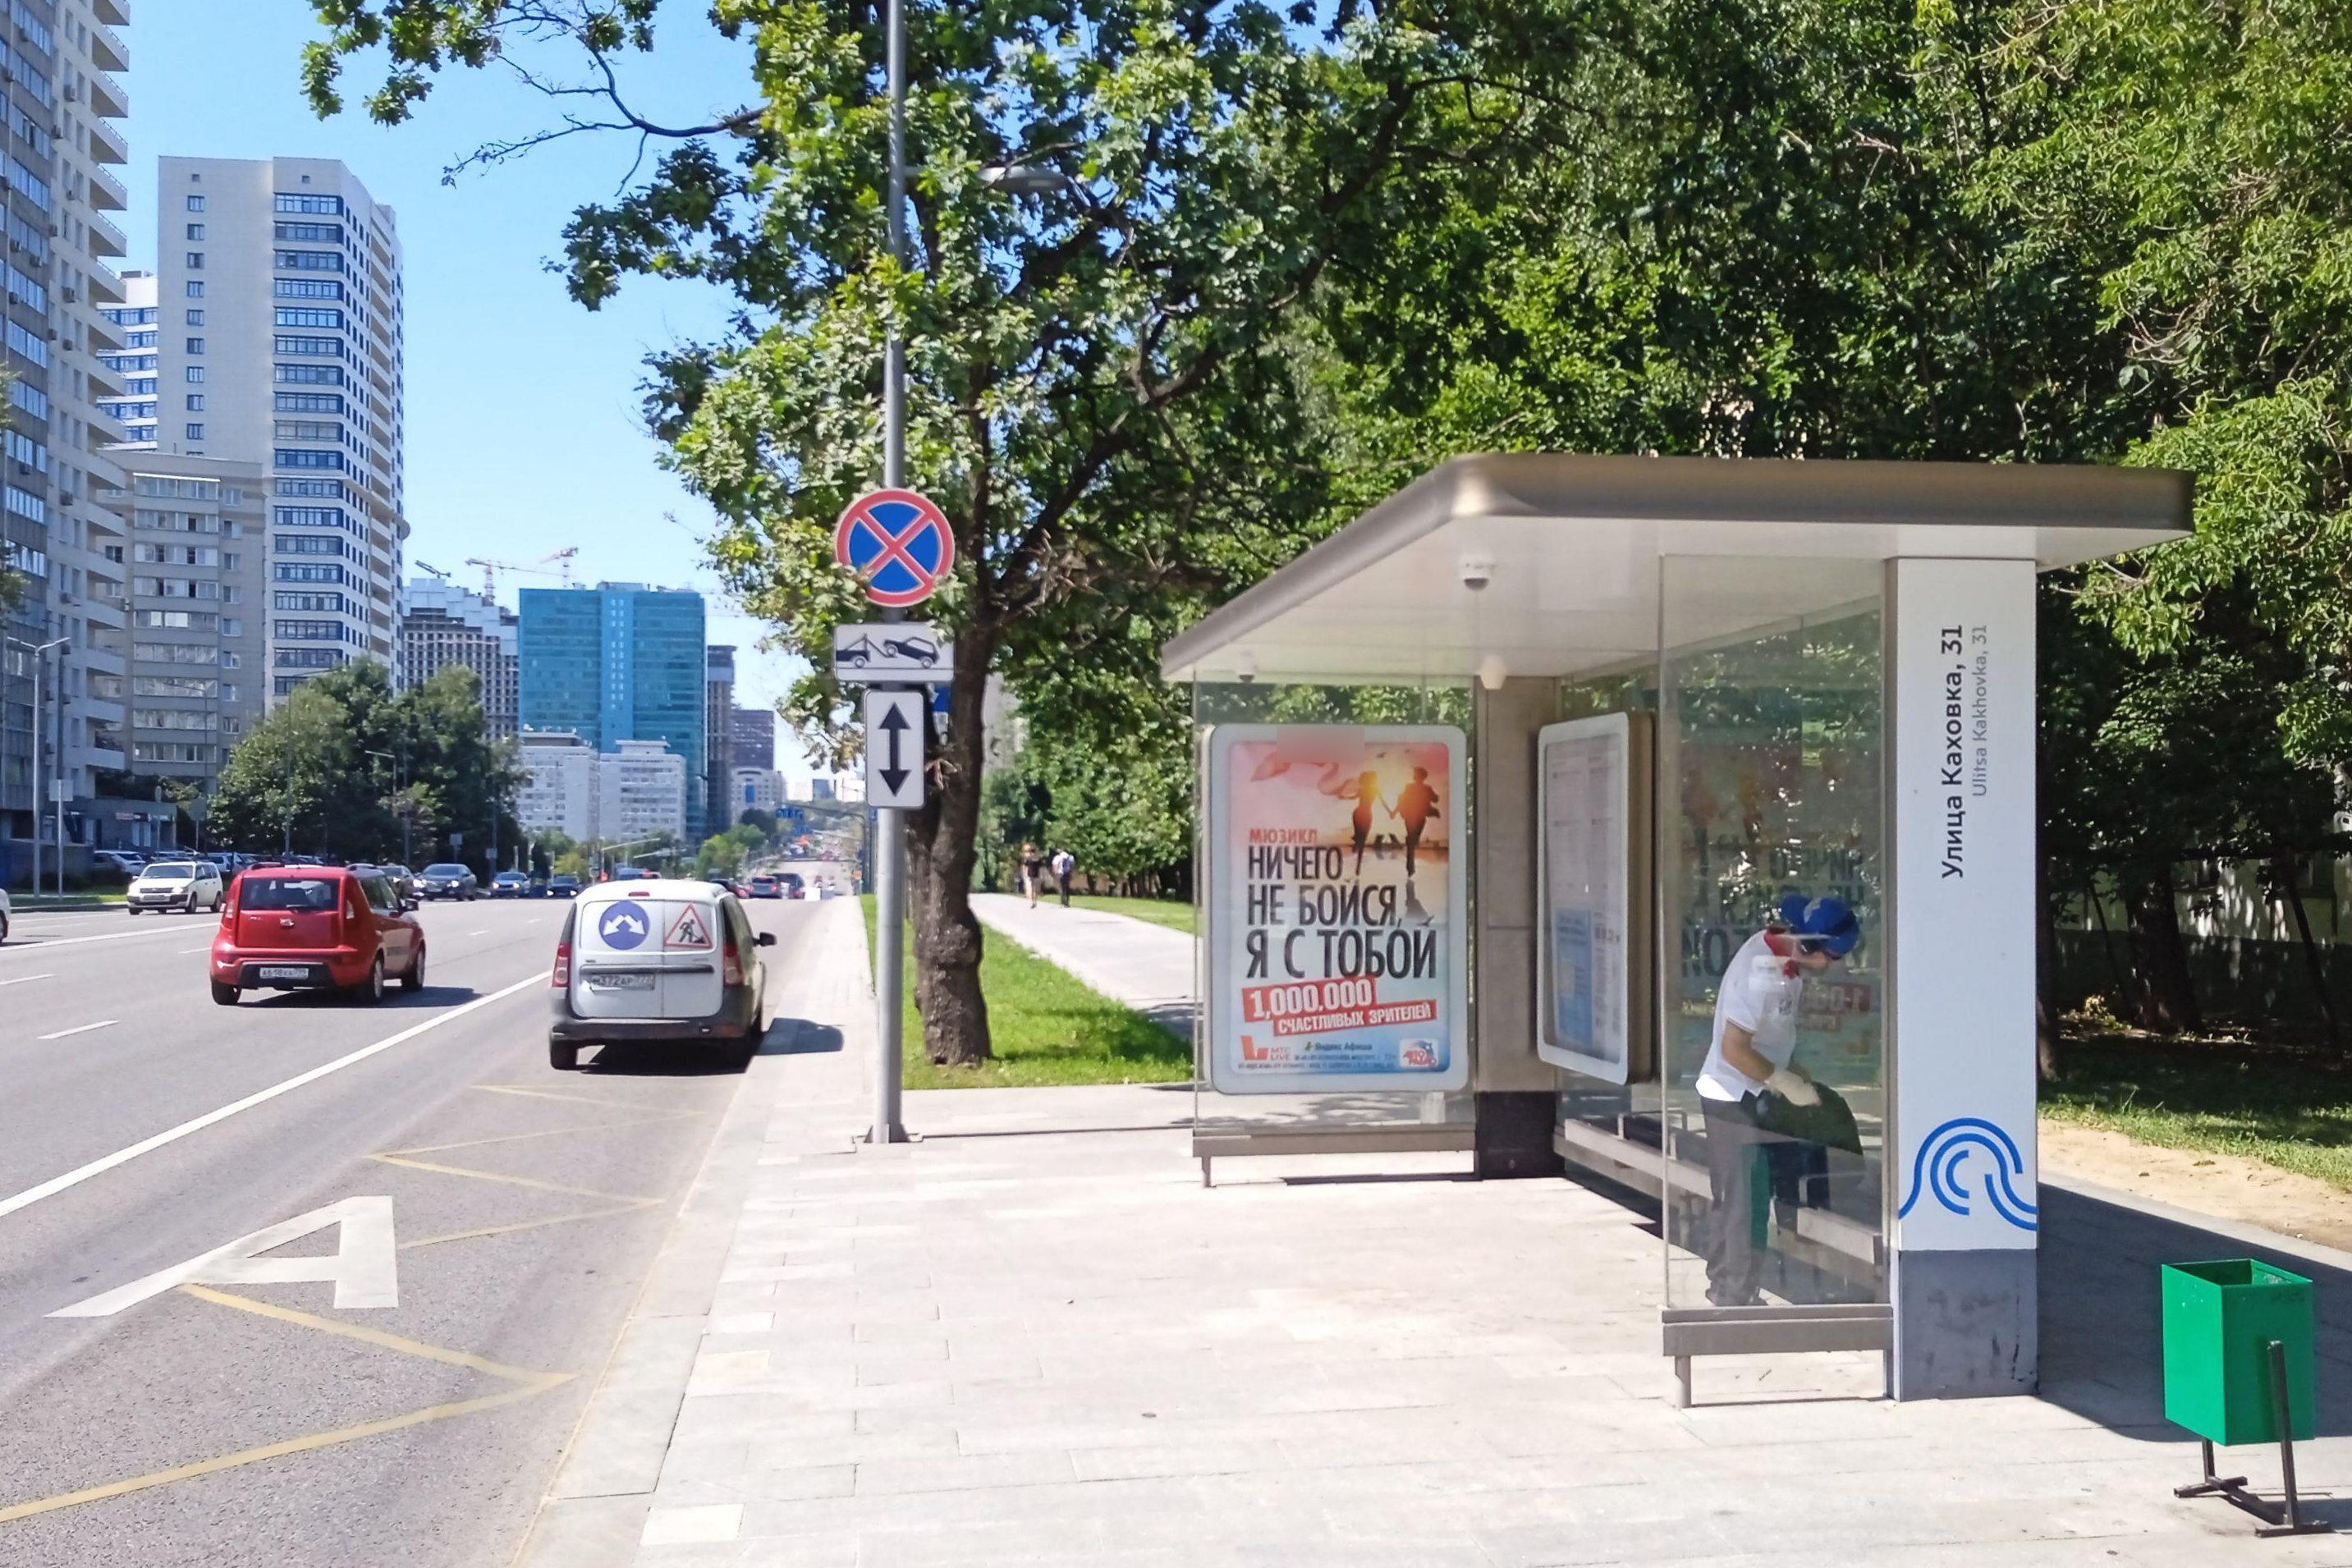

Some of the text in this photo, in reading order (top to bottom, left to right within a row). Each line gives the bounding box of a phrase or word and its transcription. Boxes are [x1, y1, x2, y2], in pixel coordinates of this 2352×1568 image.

[1971, 624, 1989, 797] Ulitsa Kakhovka, 31
[1941, 624, 1967, 878] Улица Каховка, 31
[1249, 828, 1318, 845] МЮЗИКЛ
[1248, 845, 1344, 880] НИЧЕГО
[1247, 883, 1286, 926] НЕ
[1246, 928, 1269, 979] Я
[1283, 928, 1306, 979] С
[1277, 1002, 1433, 1035] СЧАСТЛИВЫХ ЗРИТЕЛЕЙ
